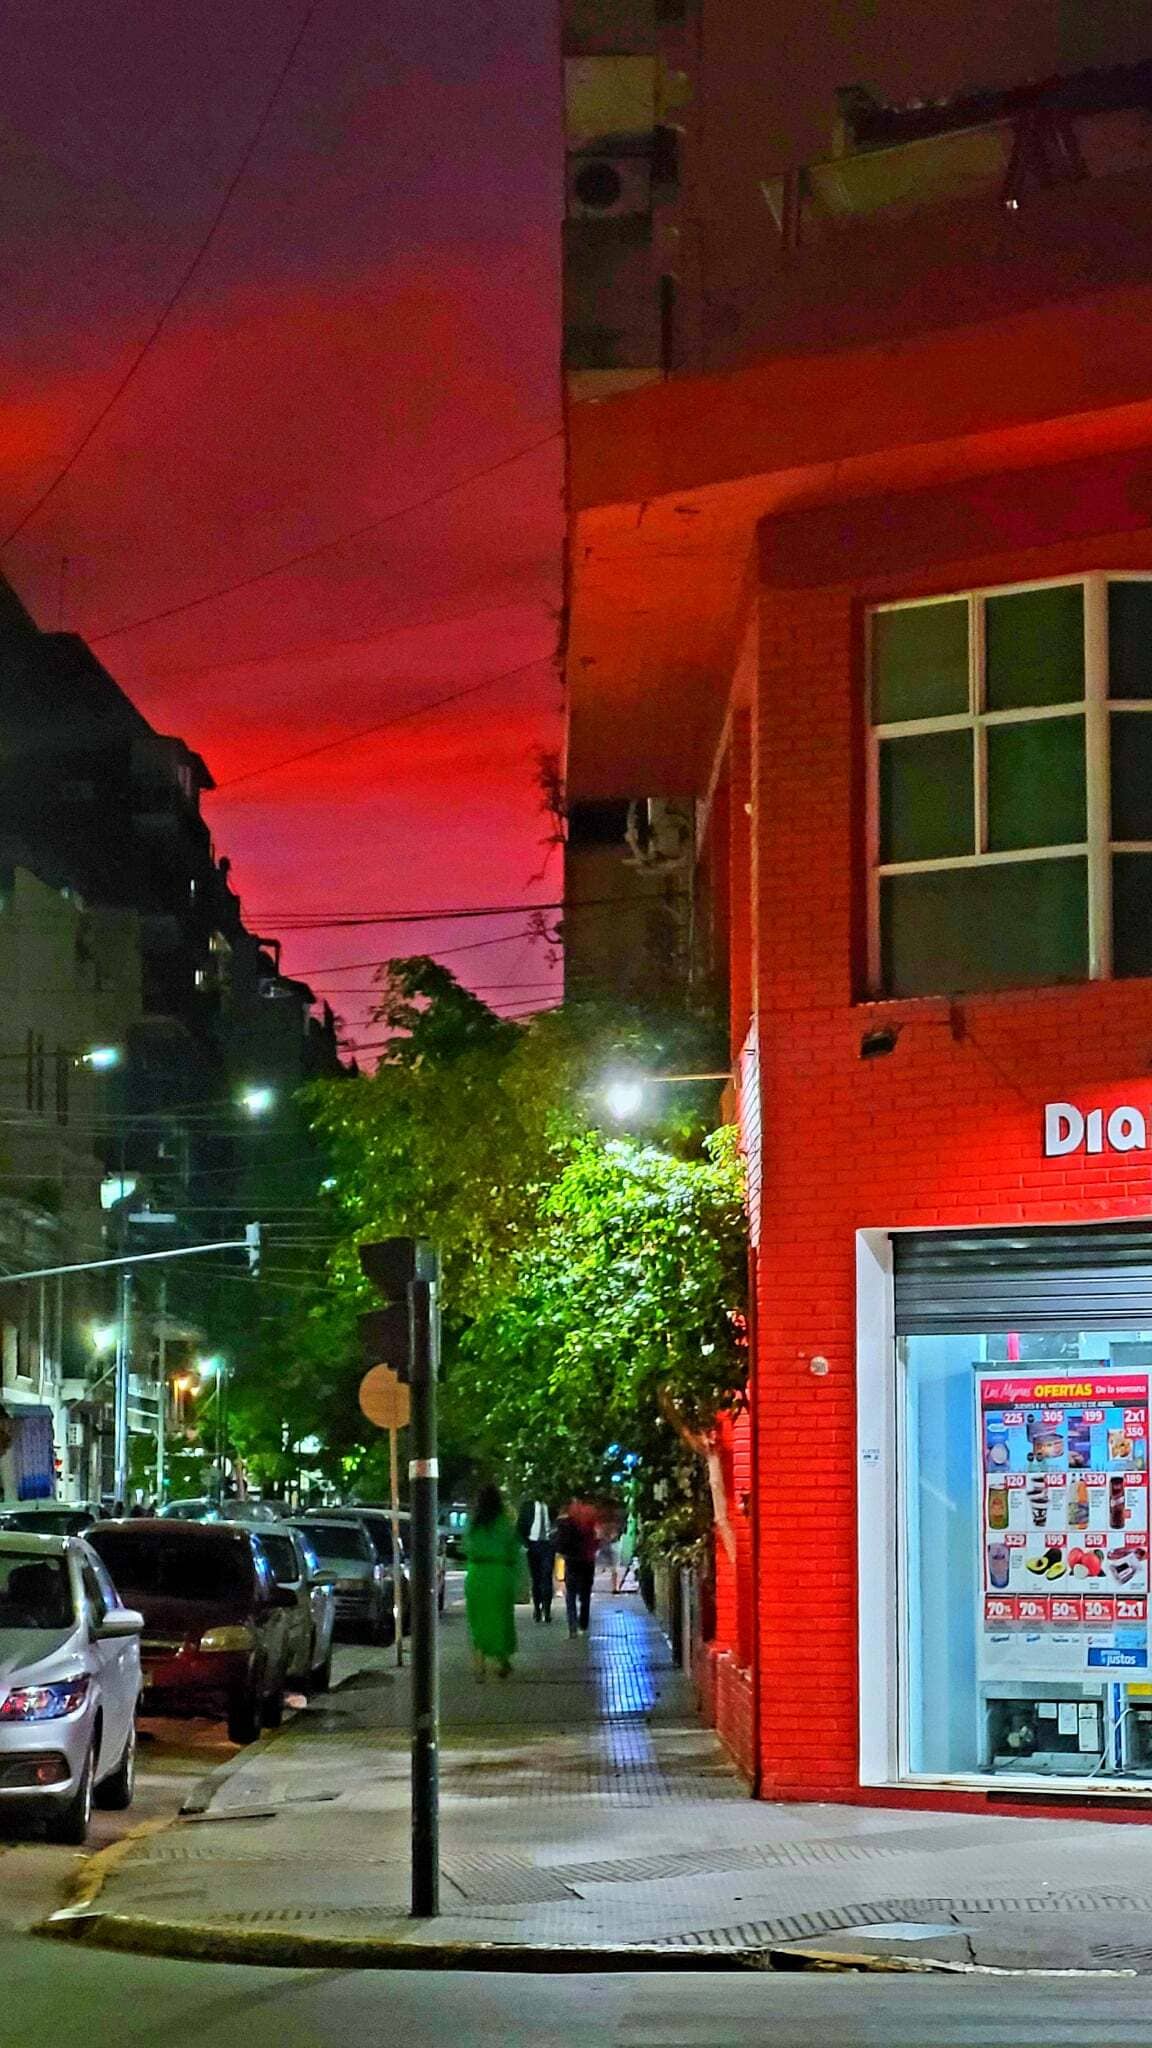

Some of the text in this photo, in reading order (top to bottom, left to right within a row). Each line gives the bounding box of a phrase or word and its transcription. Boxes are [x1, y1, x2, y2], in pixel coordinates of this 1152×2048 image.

[1034, 1384, 1092, 1397] OFERTAS
[1004, 1413, 1023, 1424] 225
[1043, 1411, 1063, 1422] 305
[1085, 1411, 1103, 1421] 199
[1124, 1410, 1145, 1422] 2x1
[1006, 1476, 1024, 1486] 120
[1046, 1535, 1064, 1546] 199
[1117, 1601, 1144, 1617] 2x1
[1106, 1654, 1136, 1666] justos
